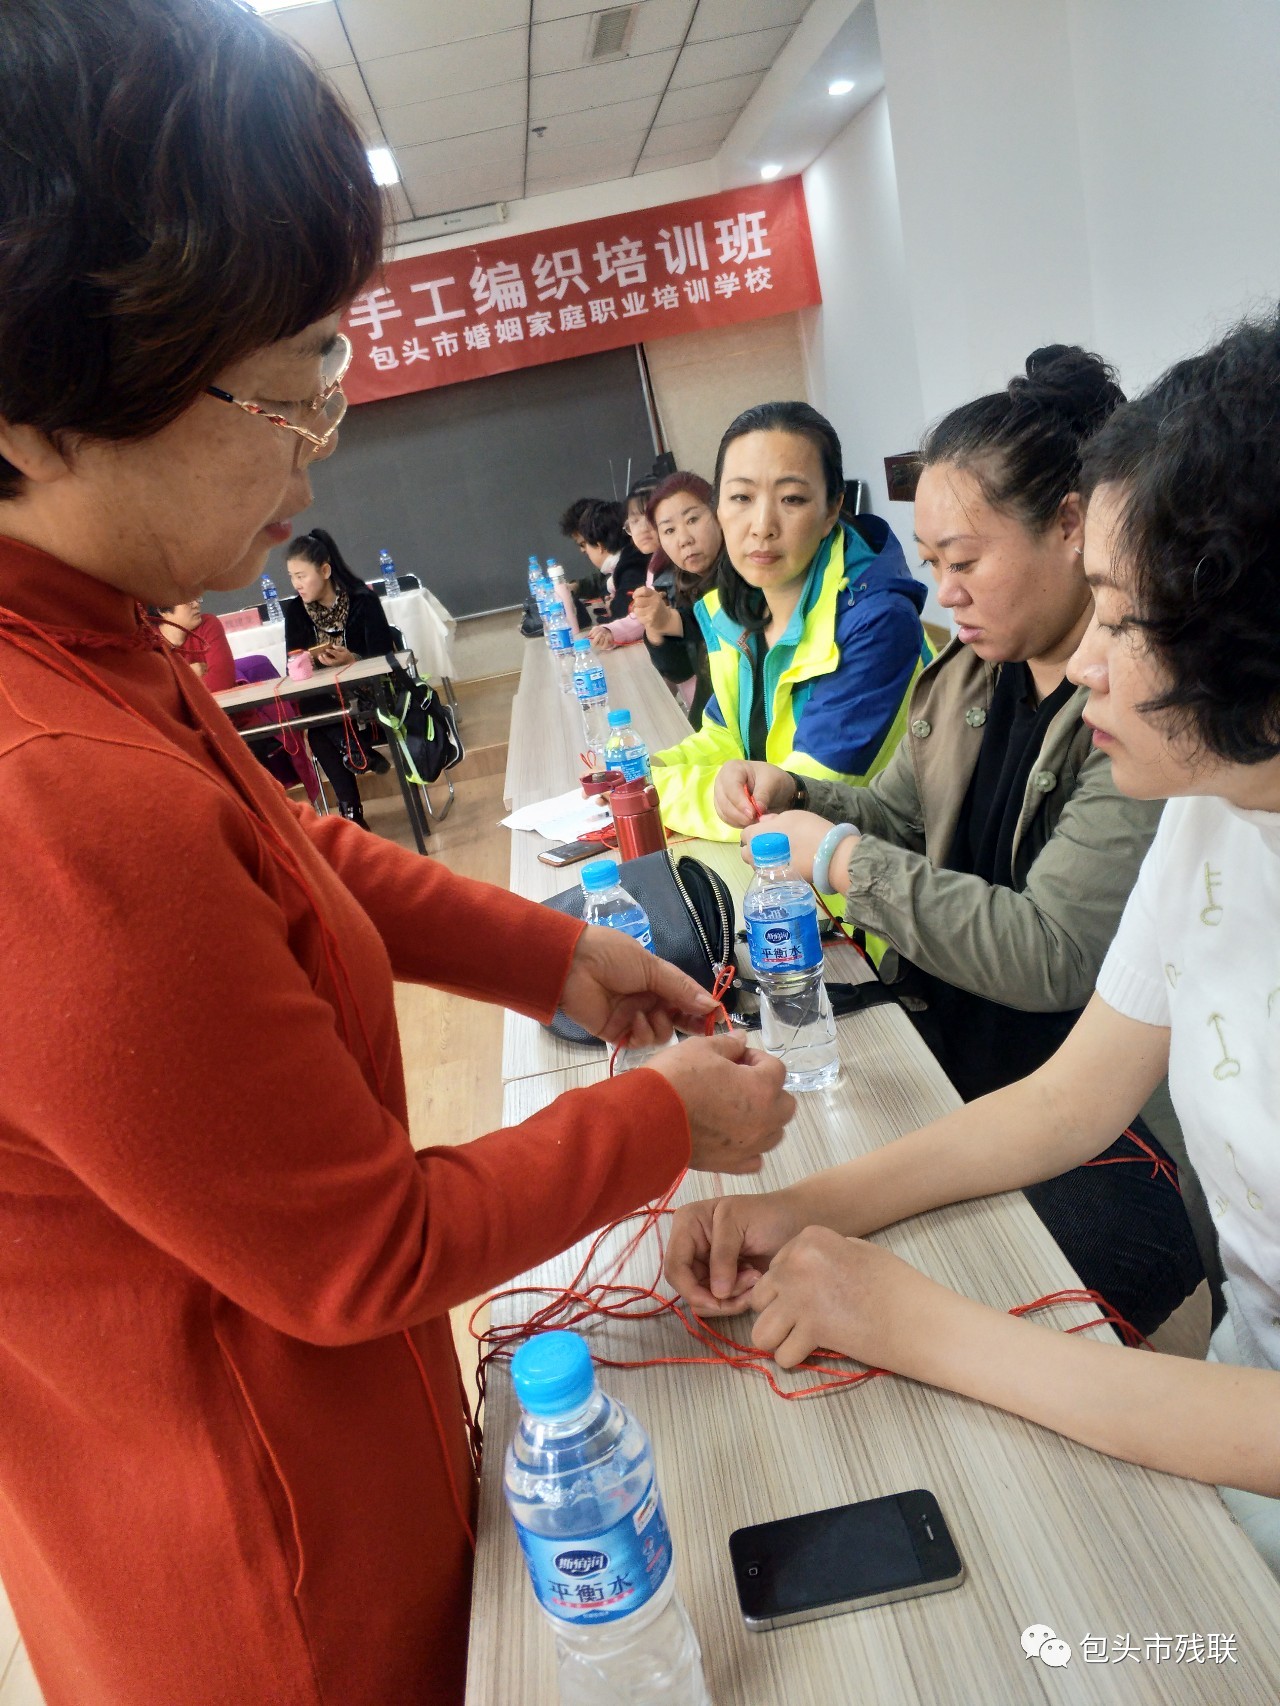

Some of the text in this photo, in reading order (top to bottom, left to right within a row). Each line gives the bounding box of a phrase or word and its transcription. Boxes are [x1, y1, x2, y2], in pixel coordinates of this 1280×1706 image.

[348, 210, 772, 341] 手工编织培训班
[368, 265, 774, 371] 包头市婚姻家庭职业培训学校
[761, 945, 802, 959] 平衡水
[547, 1571, 634, 1603] 平衡水
